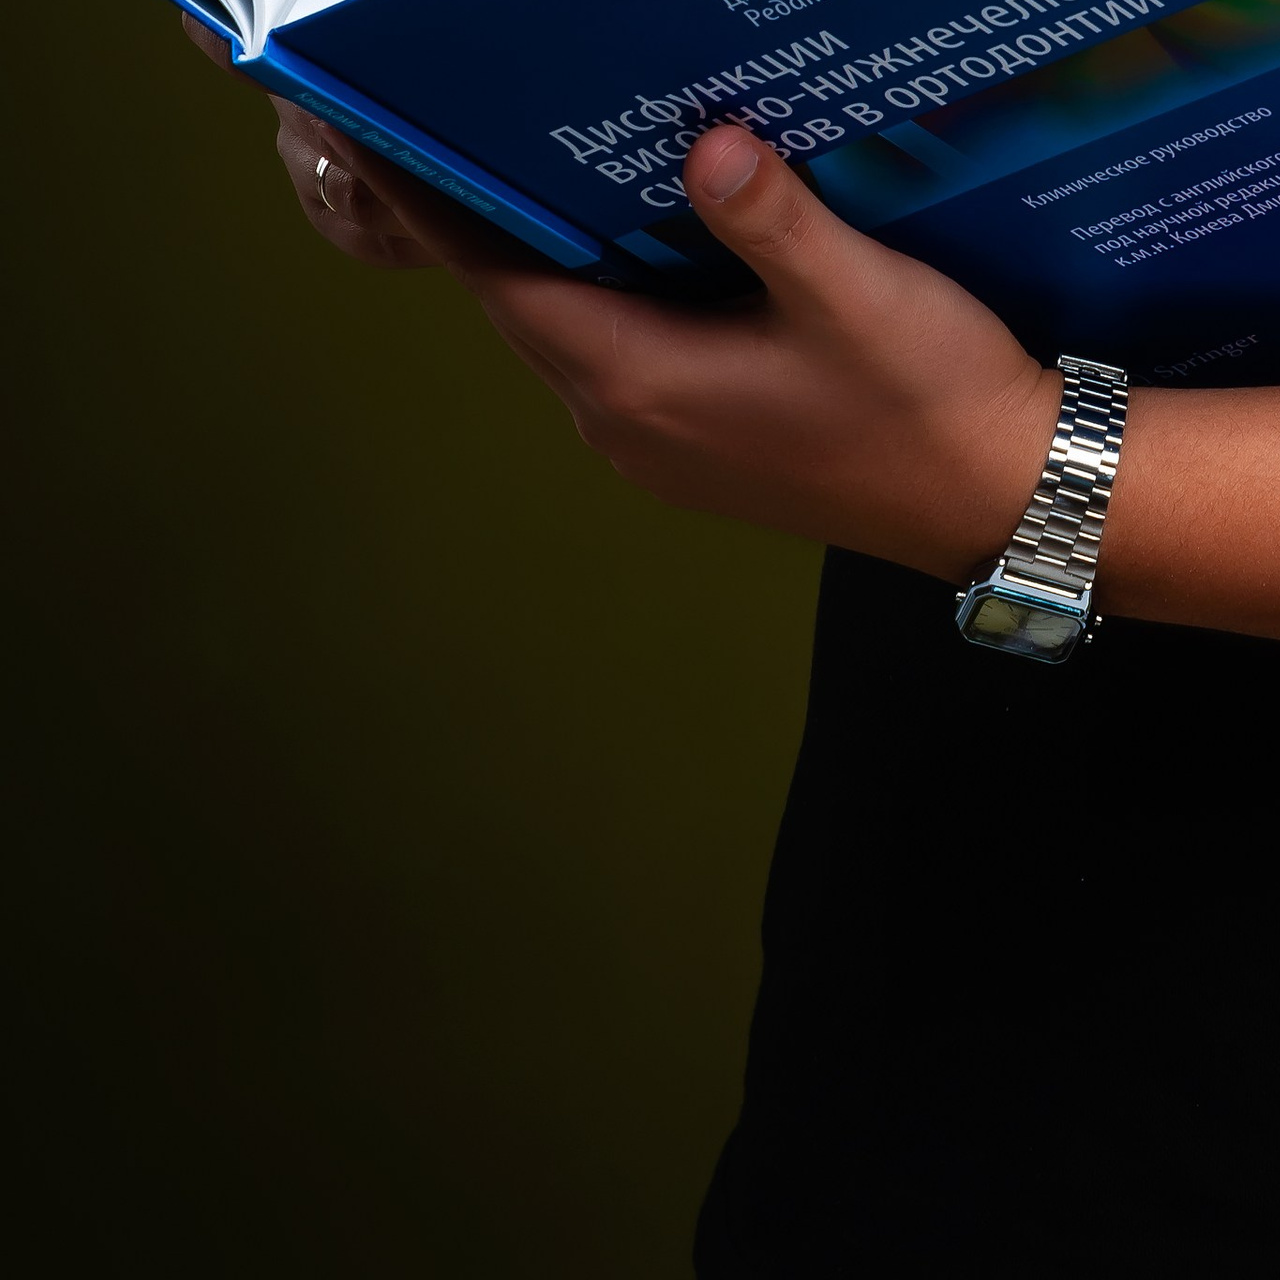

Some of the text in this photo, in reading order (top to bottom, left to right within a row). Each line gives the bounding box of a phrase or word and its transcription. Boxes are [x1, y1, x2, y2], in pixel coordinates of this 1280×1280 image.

[549, 30, 850, 165] Дисфункции
[843, 101, 885, 125] в
[1022, 106, 1273, 209] Клиническое руководство
[1070, 204, 1160, 241] Перевод
[1158, 197, 1174, 208] с
[1094, 234, 1137, 256] под
[1131, 201, 1215, 239] научной
[1113, 242, 1175, 267] к.м.н.
[1169, 212, 1245, 245] Конева
[1153, 333, 1260, 378] Springer
